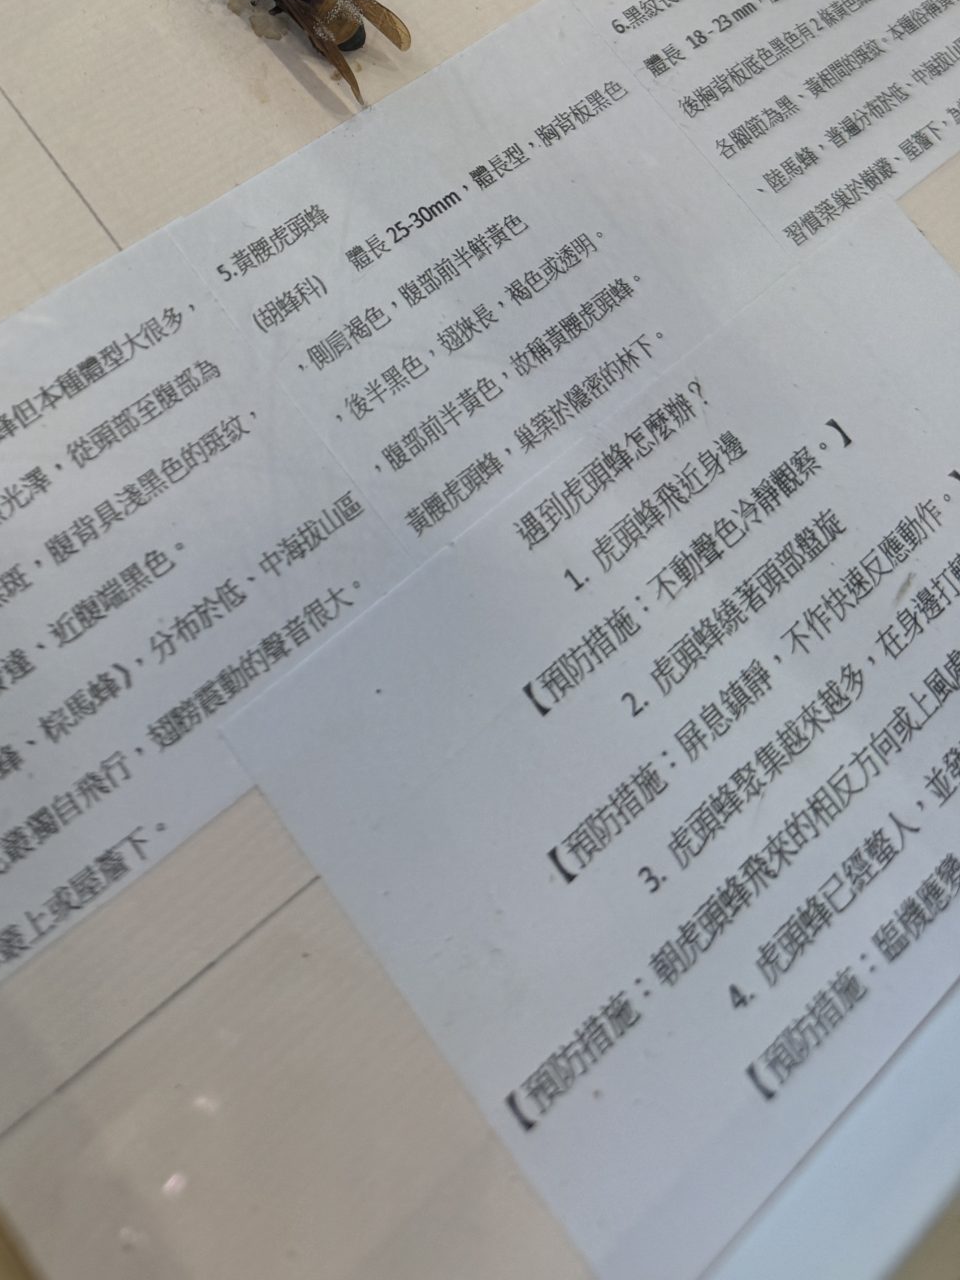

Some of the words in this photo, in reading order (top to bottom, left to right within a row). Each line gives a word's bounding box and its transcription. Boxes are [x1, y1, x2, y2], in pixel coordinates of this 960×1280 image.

[642, 43, 687, 79] 體長
[685, 29, 709, 50] 18
[711, 14, 734, 33] 23
[216, 204, 330, 283] 5.黃腰虎頭蜂
[344, 233, 392, 272] 體長
[513, 381, 708, 551] 遇到虎頭蜂怎麼辦？
[564, 568, 590, 592] 1.
[591, 430, 748, 573] 虎頭蜂飛近身邊
[620, 691, 650, 718] 2.
[649, 508, 847, 697] 虎頭蜂繞著頭部盤旋
[637, 866, 668, 894] 3.
[729, 984, 756, 1009] 4.
